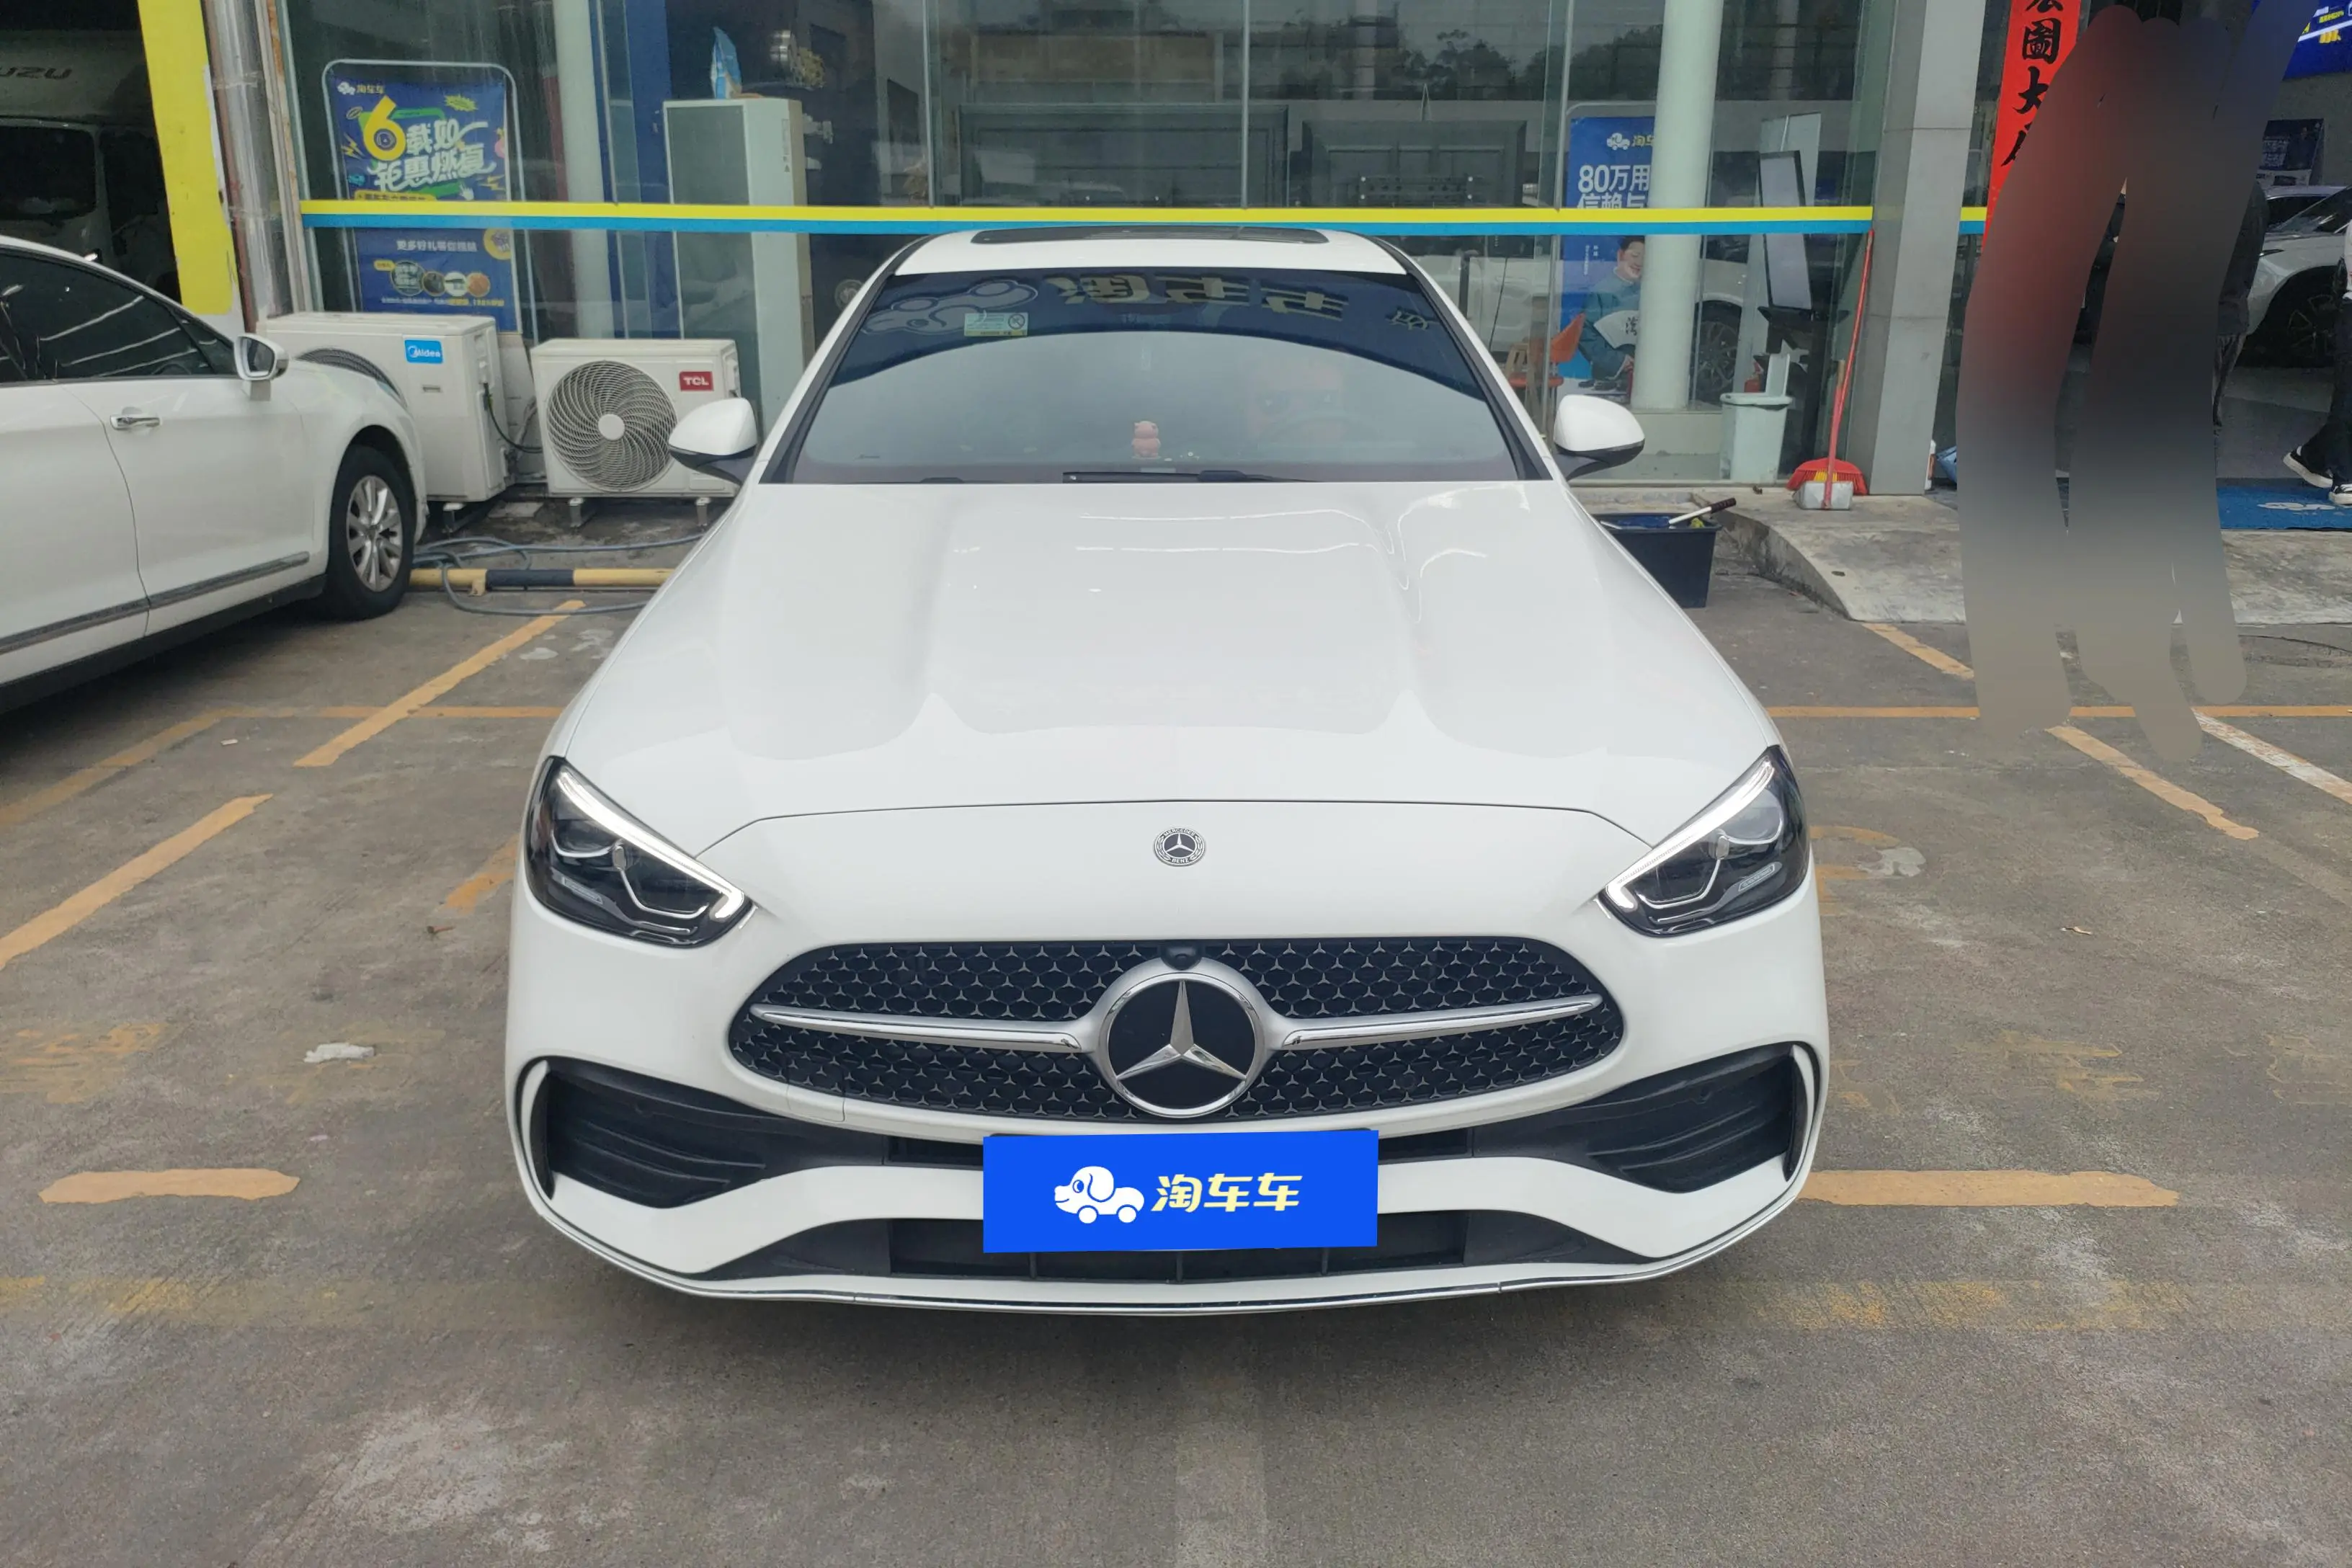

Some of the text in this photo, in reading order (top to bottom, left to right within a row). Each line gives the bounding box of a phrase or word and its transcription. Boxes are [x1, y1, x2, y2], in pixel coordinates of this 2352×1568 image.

[2000, 0, 2064, 166] 圖大
[1578, 165, 1651, 192] 80万用
[682, 375, 710, 386] TCL
